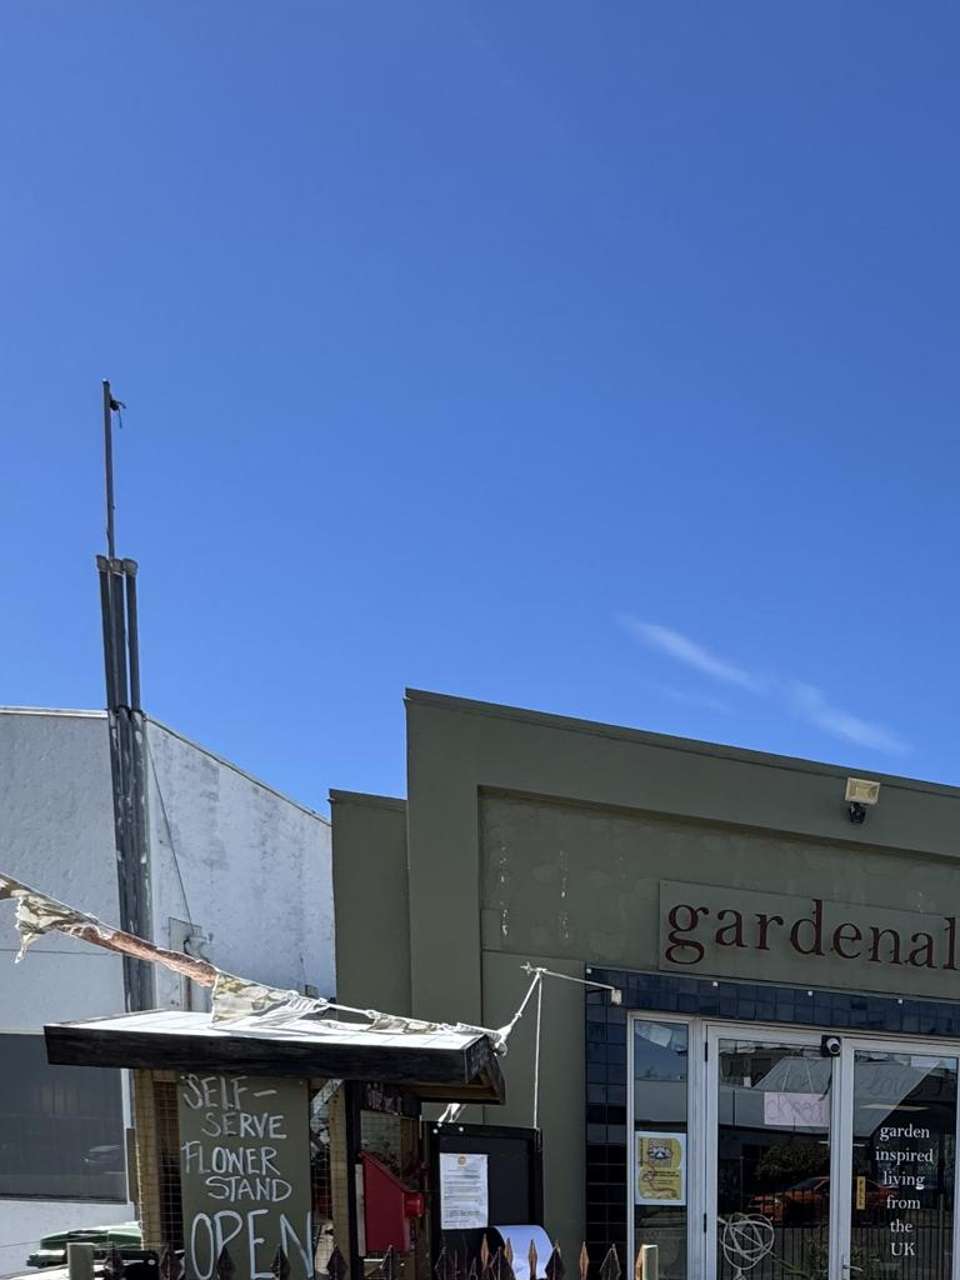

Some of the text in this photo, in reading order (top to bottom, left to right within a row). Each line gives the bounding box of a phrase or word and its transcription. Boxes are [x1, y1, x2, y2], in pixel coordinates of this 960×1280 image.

[201, 1112, 287, 1139] SERVE
[880, 1123, 930, 1141] garden
[181, 1140, 281, 1175] FLOWER
[875, 1146, 934, 1165] inspired
[205, 1176, 292, 1202] STAND
[883, 1170, 926, 1190] living
[886, 1194, 921, 1209] from
[890, 1218, 913, 1233] the
[191, 1209, 314, 1280] OPEN
[890, 1242, 915, 1256] UK
